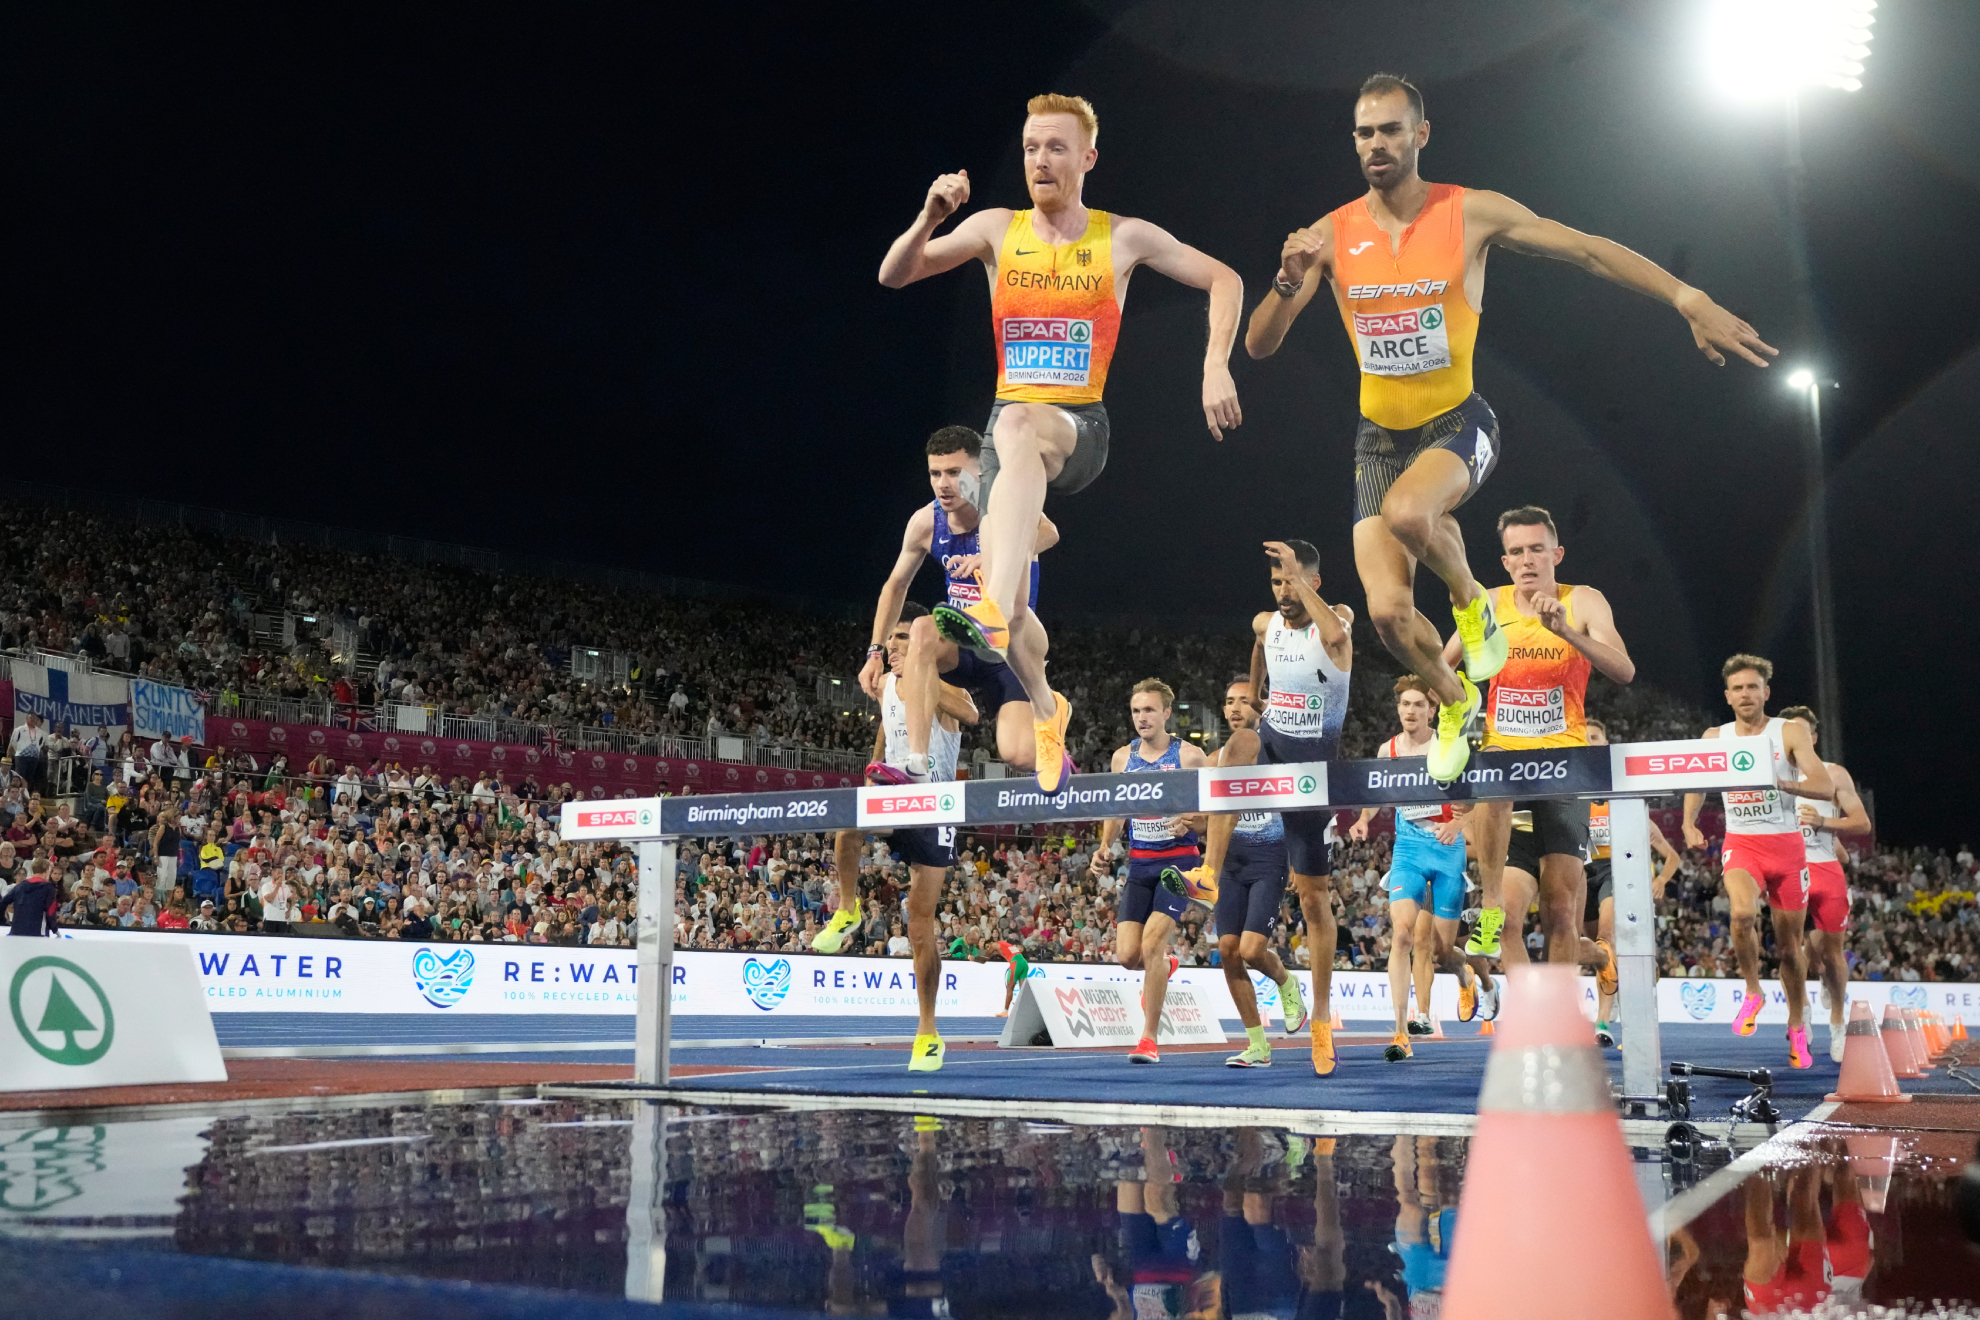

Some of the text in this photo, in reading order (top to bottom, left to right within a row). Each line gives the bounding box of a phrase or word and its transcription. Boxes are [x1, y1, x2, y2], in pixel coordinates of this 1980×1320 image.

[1006, 269, 1103, 291] GERMANY
[1347, 279, 1449, 299] ESPAÑA
[1006, 322, 1067, 338] SPAR
[1355, 315, 1417, 334] SPAR
[1370, 335, 1429, 359] ARCE
[1005, 346, 1090, 368] RUPPERT
[1364, 357, 1447, 372] BIRMINGHAM 2026
[1008, 371, 1085, 382] BIRMINGHAM 2026
[949, 585, 981, 599] SPA
[1275, 654, 1305, 662] ITALIA
[1507, 647, 1564, 660] ERMANY
[1271, 692, 1305, 707] SPAR
[1500, 691, 1547, 705] SPAR
[18, 693, 117, 726] SUMIAINEN
[1496, 706, 1564, 724] BUCHHOLZ
[1497, 724, 1564, 734] BIRMINGHAM 2026
[1509, 759, 1568, 781] 2026
[1648, 755, 1726, 772] SPAR
[1114, 781, 1164, 801] 2026
[1229, 779, 1293, 795] SPAR
[881, 797, 937, 813] SPAR
[1728, 791, 1764, 803] SPAR
[590, 812, 637, 825] SPAR
[687, 800, 828, 825] Birmingham 2026
[1733, 804, 1773, 817] DARU
[945, 827, 952, 843] 5
[198, 952, 342, 979] WATER
[503, 961, 687, 985] RE:WATR
[813, 969, 958, 991] RE:WATR
[256, 987, 342, 999] ALUMINIUM
[503, 990, 536, 1001] 100%
[543, 991, 610, 1002] RECYCLED
[813, 995, 838, 1005] 100%
[843, 996, 895, 1006] RECYCLED
[1089, 1006, 1127, 1022] MODYF
[1169, 1007, 1202, 1022] MODYF
[1096, 1025, 1136, 1037] WORKWEAR
[1174, 1025, 1209, 1036] WORKWEAR
